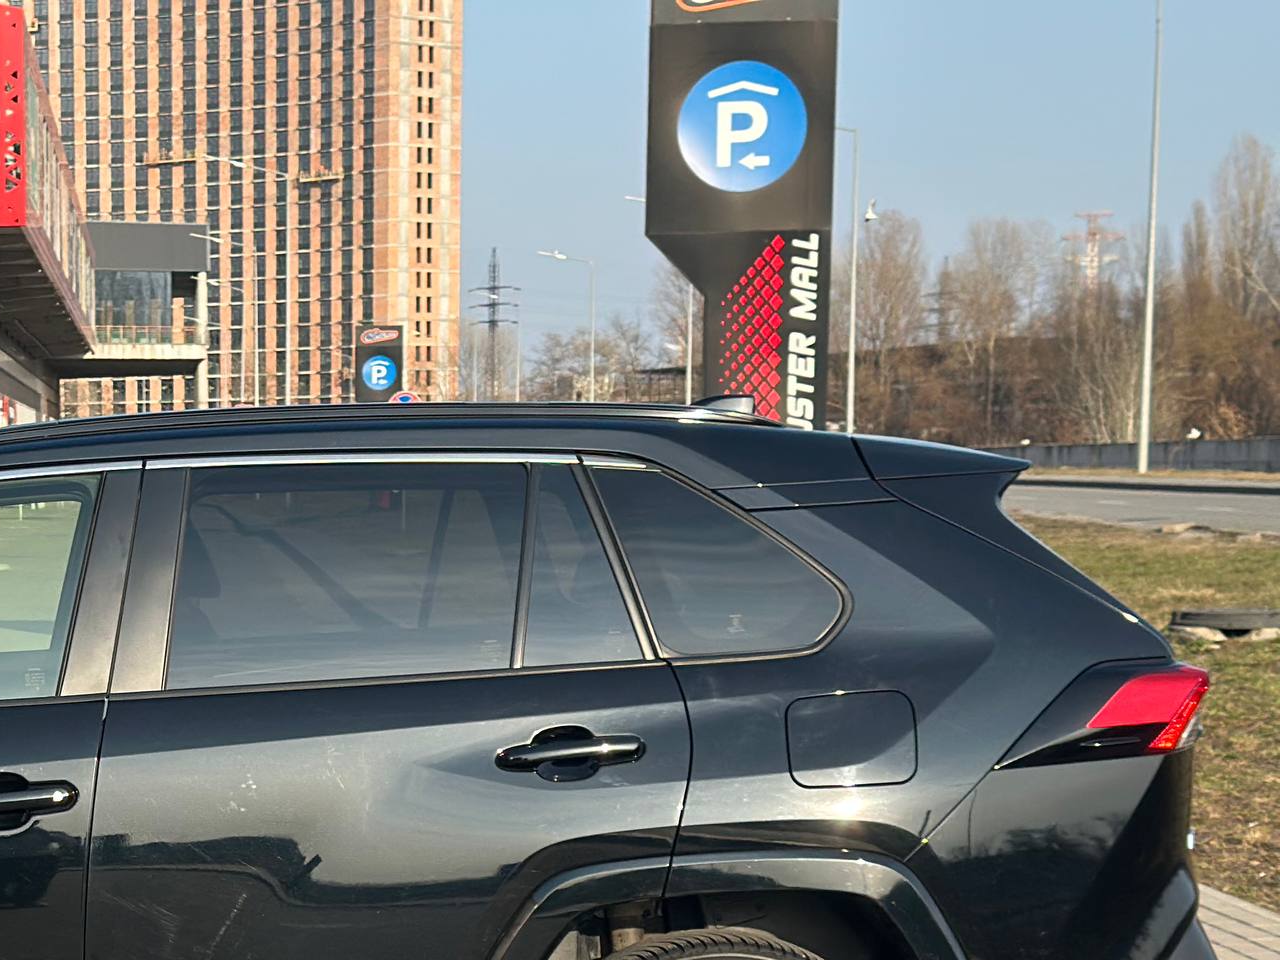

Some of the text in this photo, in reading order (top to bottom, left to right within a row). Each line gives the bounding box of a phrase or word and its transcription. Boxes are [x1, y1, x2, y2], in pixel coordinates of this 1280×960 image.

[715, 100, 769, 168] P
[788, 233, 819, 321] MALL
[370, 365, 388, 385] P
